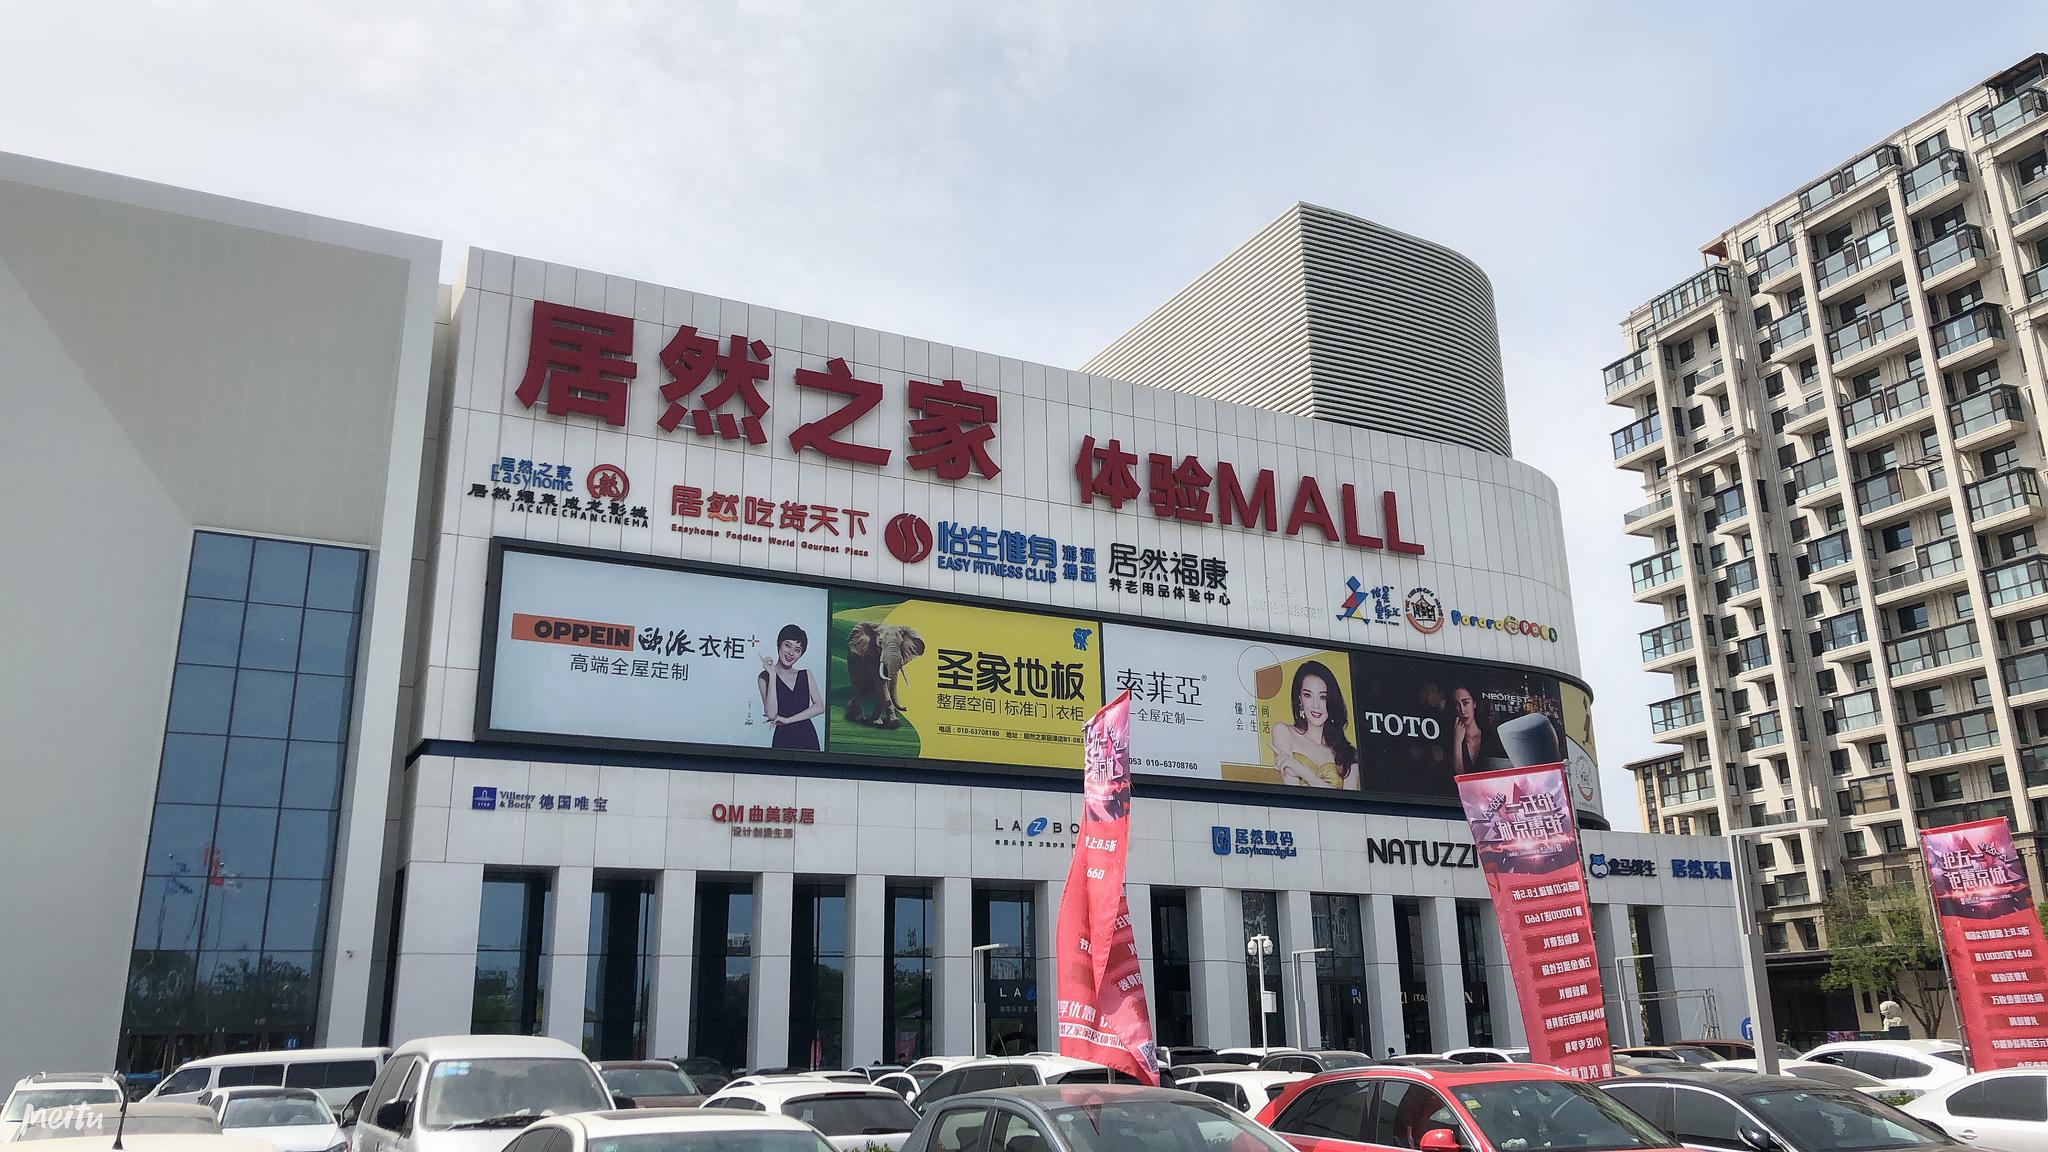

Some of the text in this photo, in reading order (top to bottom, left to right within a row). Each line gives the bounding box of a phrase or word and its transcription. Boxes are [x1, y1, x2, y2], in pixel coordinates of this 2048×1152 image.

[515, 300, 1001, 480] 居然之家
[491, 463, 573, 492] Easyhome
[500, 457, 572, 480] 居然之家
[1075, 435, 1425, 555] 体验MALL
[511, 502, 649, 528] JACKIE CHAN CINEMA
[671, 485, 870, 540] 居然吃货天下
[671, 524, 869, 557] Easyhome Foodies World Gourmet Plaza
[937, 521, 1058, 568] 怡生健身
[938, 556, 1057, 583] EASY FITNESS CLUB
[1109, 543, 1229, 590] 居然福康
[1109, 578, 1231, 605] 养老用品体验中心
[534, 620, 631, 648] OPPEIN
[698, 634, 746, 660] 衣柜
[570, 653, 690, 681] 高端全屋定制
[937, 649, 1085, 702] 圣象地板
[936, 693, 1085, 722] 整屋空间 标准门 衣柜
[1481, 692, 1529, 703] NEOREST
[1137, 708, 1186, 725] 全屋定制
[1365, 711, 1440, 740] TOTO
[1146, 759, 1198, 770] 010-63708760
[500, 790, 537, 803] Villeroy
[508, 799, 531, 809] Boch
[539, 793, 609, 812] 德国唯宝
[712, 803, 815, 825] QM 曲美家居
[1085, 835, 1118, 852] 上8.5折
[1235, 828, 1294, 846] 居然数码
[1366, 838, 1479, 868] NATUZZI
